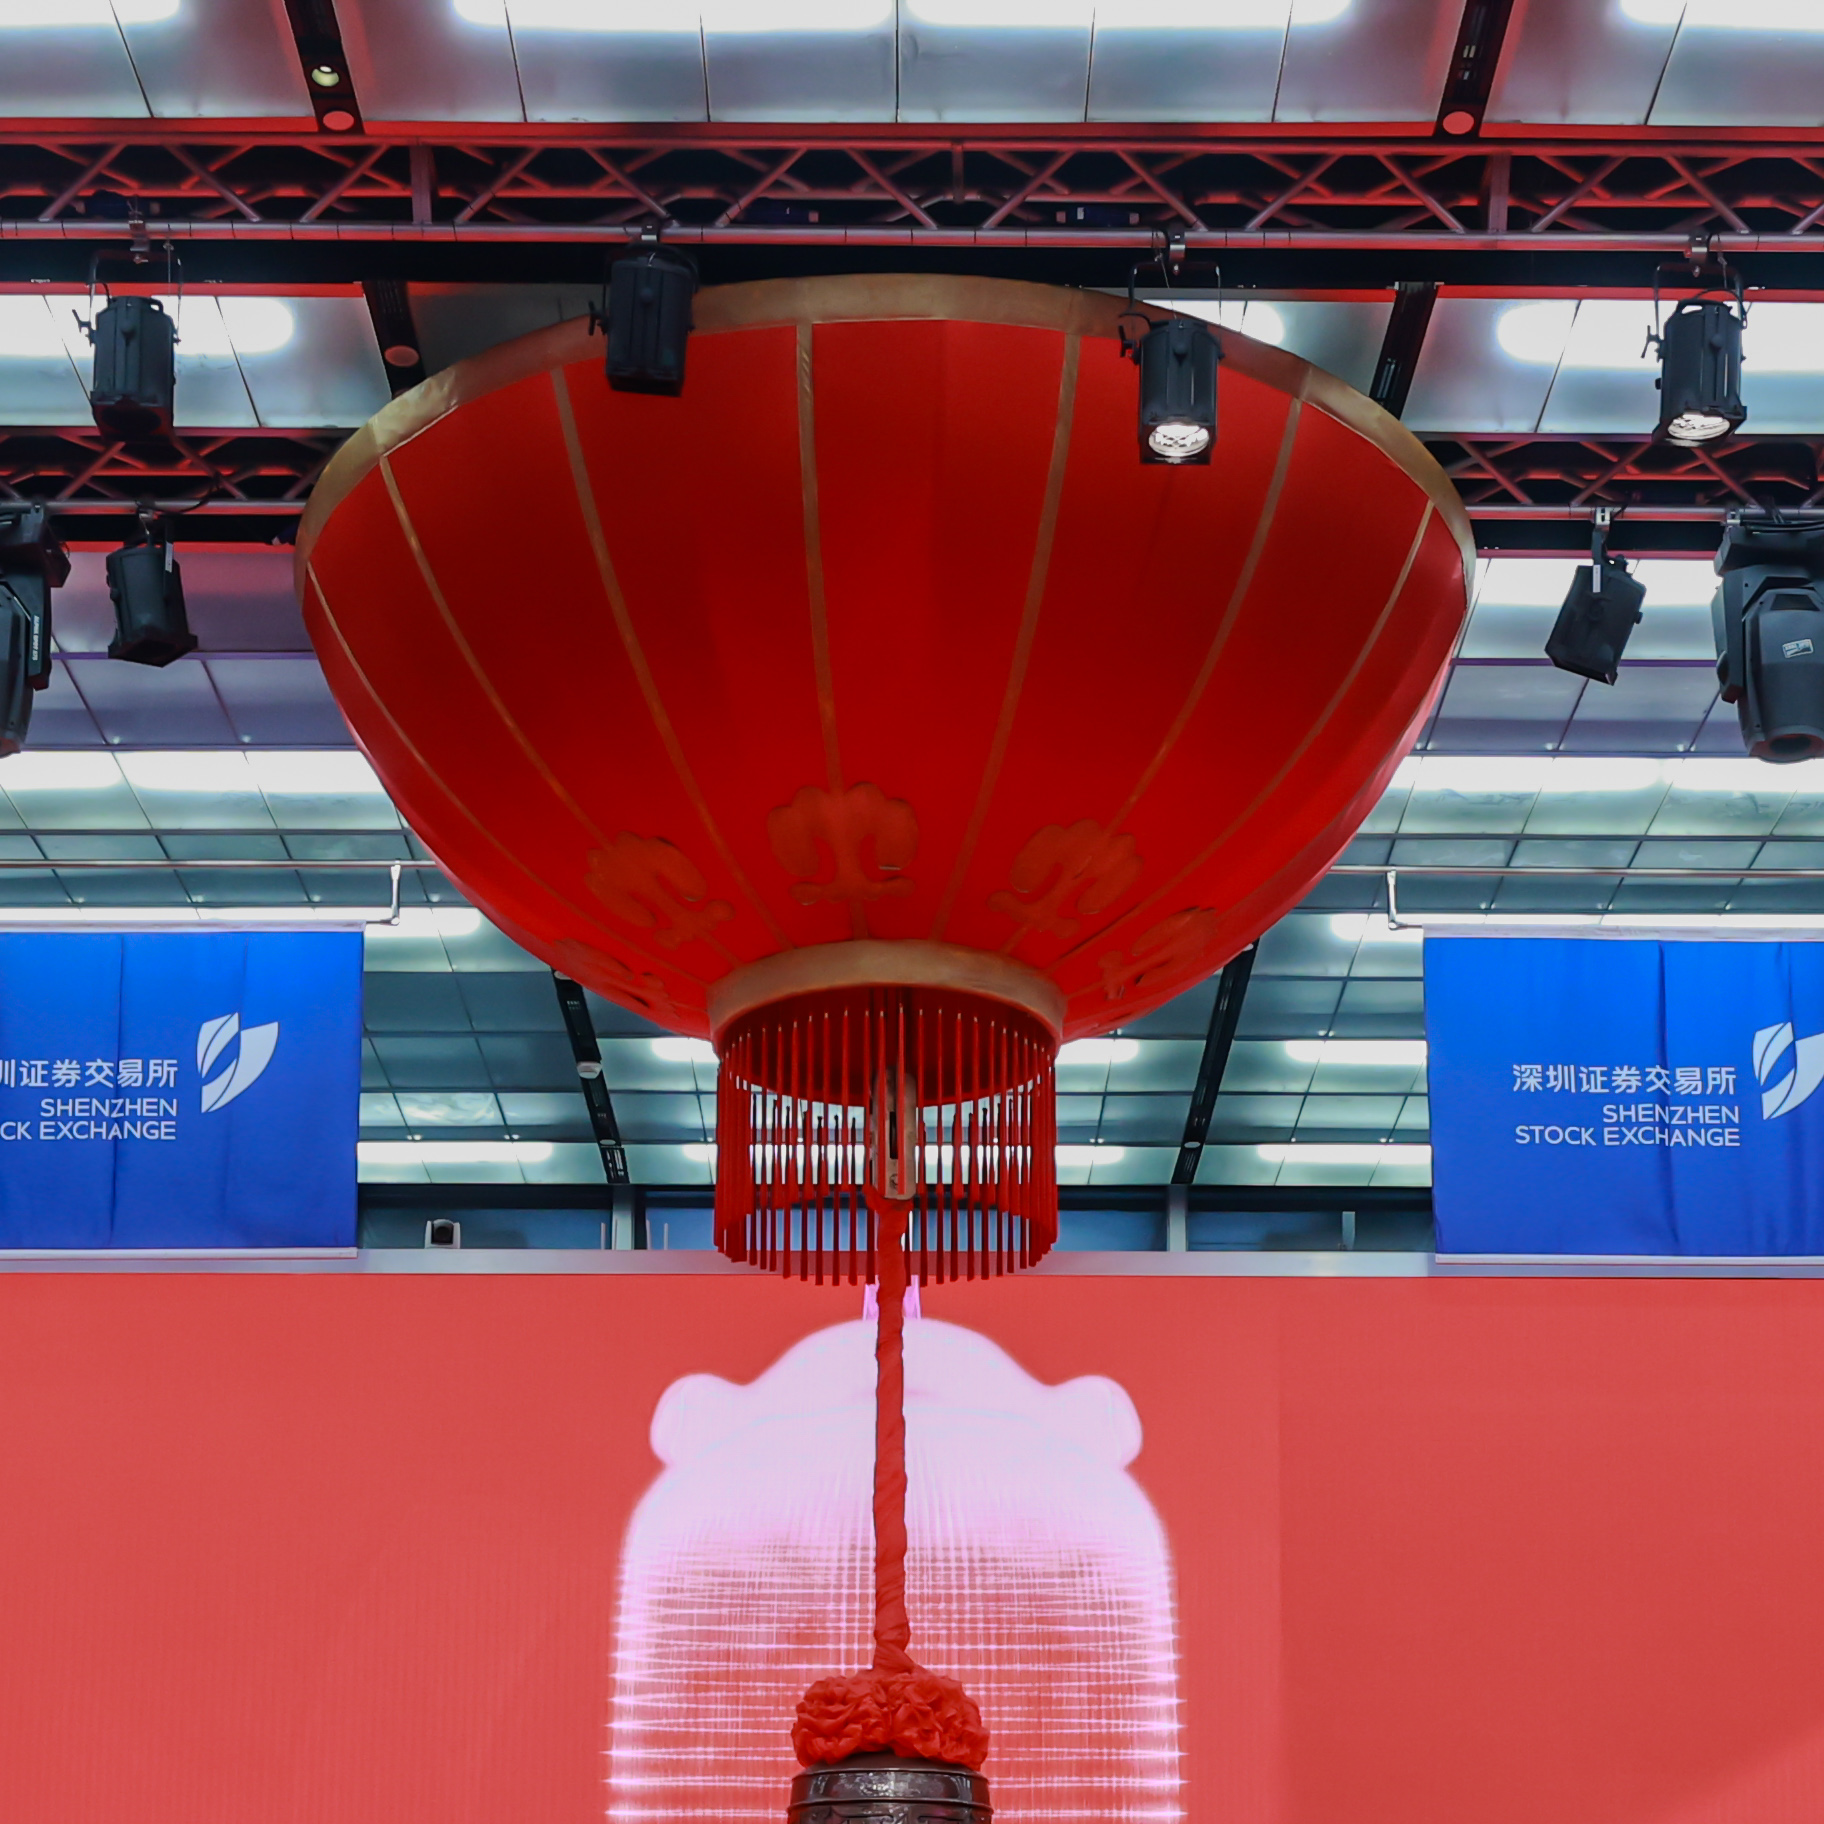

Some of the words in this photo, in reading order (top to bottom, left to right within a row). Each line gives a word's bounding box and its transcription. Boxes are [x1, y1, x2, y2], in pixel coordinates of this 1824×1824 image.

[1512, 1064, 1737, 1096] 深圳证券交易所
[40, 1097, 177, 1118] SHENZHEN
[1602, 1103, 1739, 1125] SHENZHEN
[39, 1120, 177, 1141] EXCHANGE
[1515, 1125, 1597, 1146] STOCK
[1603, 1126, 1741, 1148] EXCHANGE
